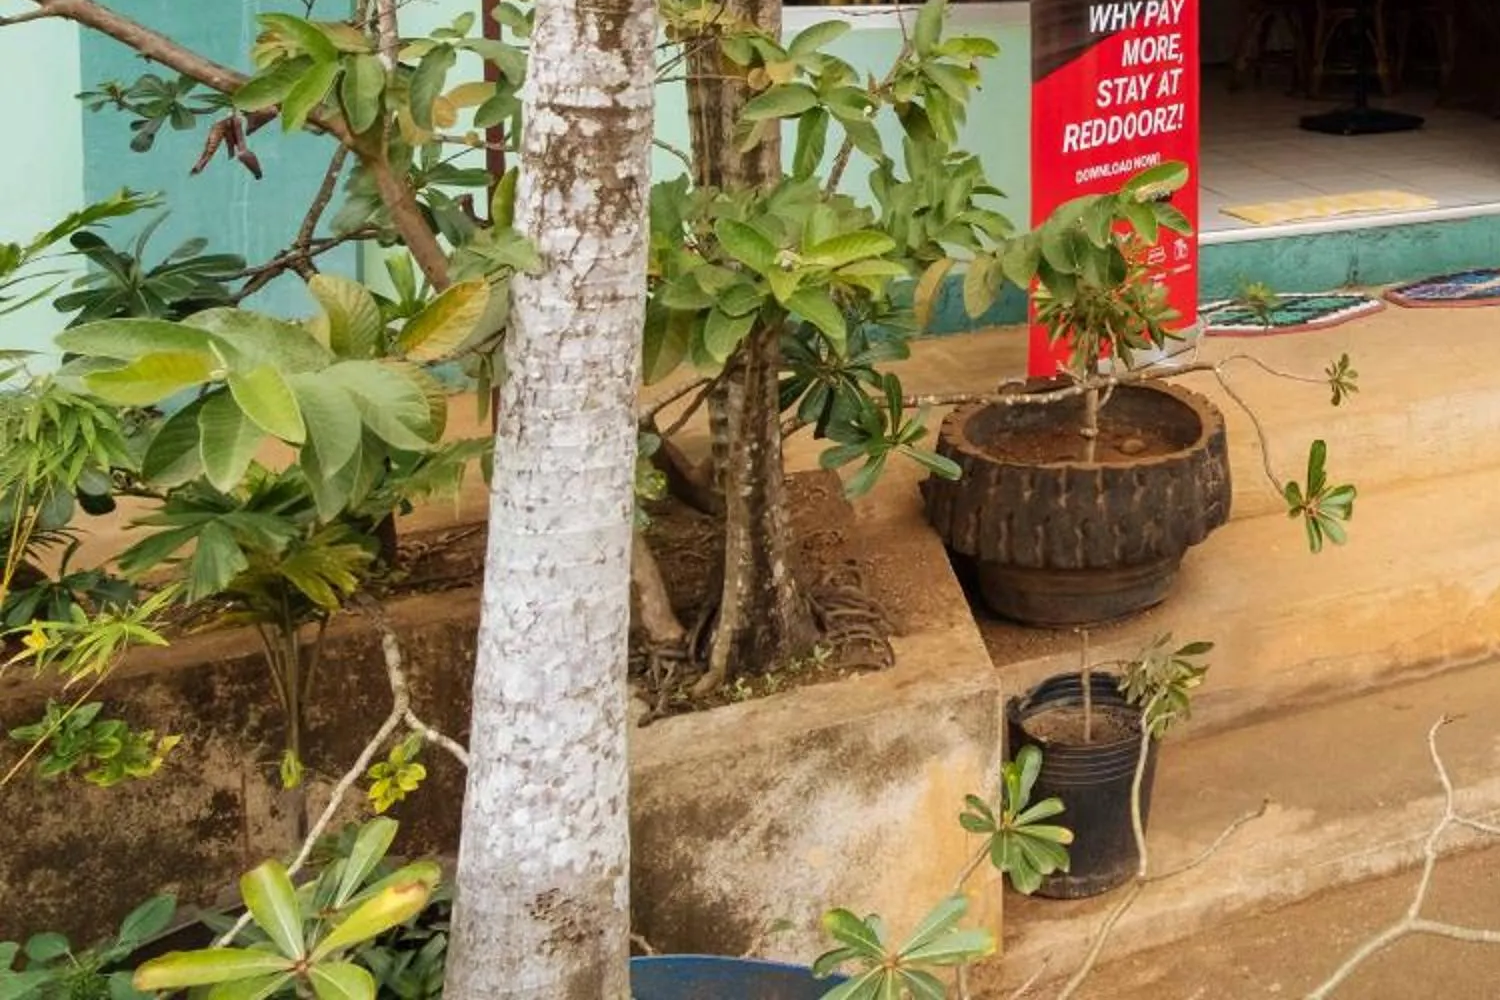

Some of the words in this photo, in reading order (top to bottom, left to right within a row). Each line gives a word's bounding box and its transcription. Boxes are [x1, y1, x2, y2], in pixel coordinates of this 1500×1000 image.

[1089, 1, 1142, 33] WHY
[1121, 33, 1183, 66] MORE,
[1097, 73, 1153, 108] STAY
[1156, 68, 1184, 99] AT
[1062, 103, 1184, 153] REDDOORZ!
[1075, 159, 1133, 184] DOWNLOAD
